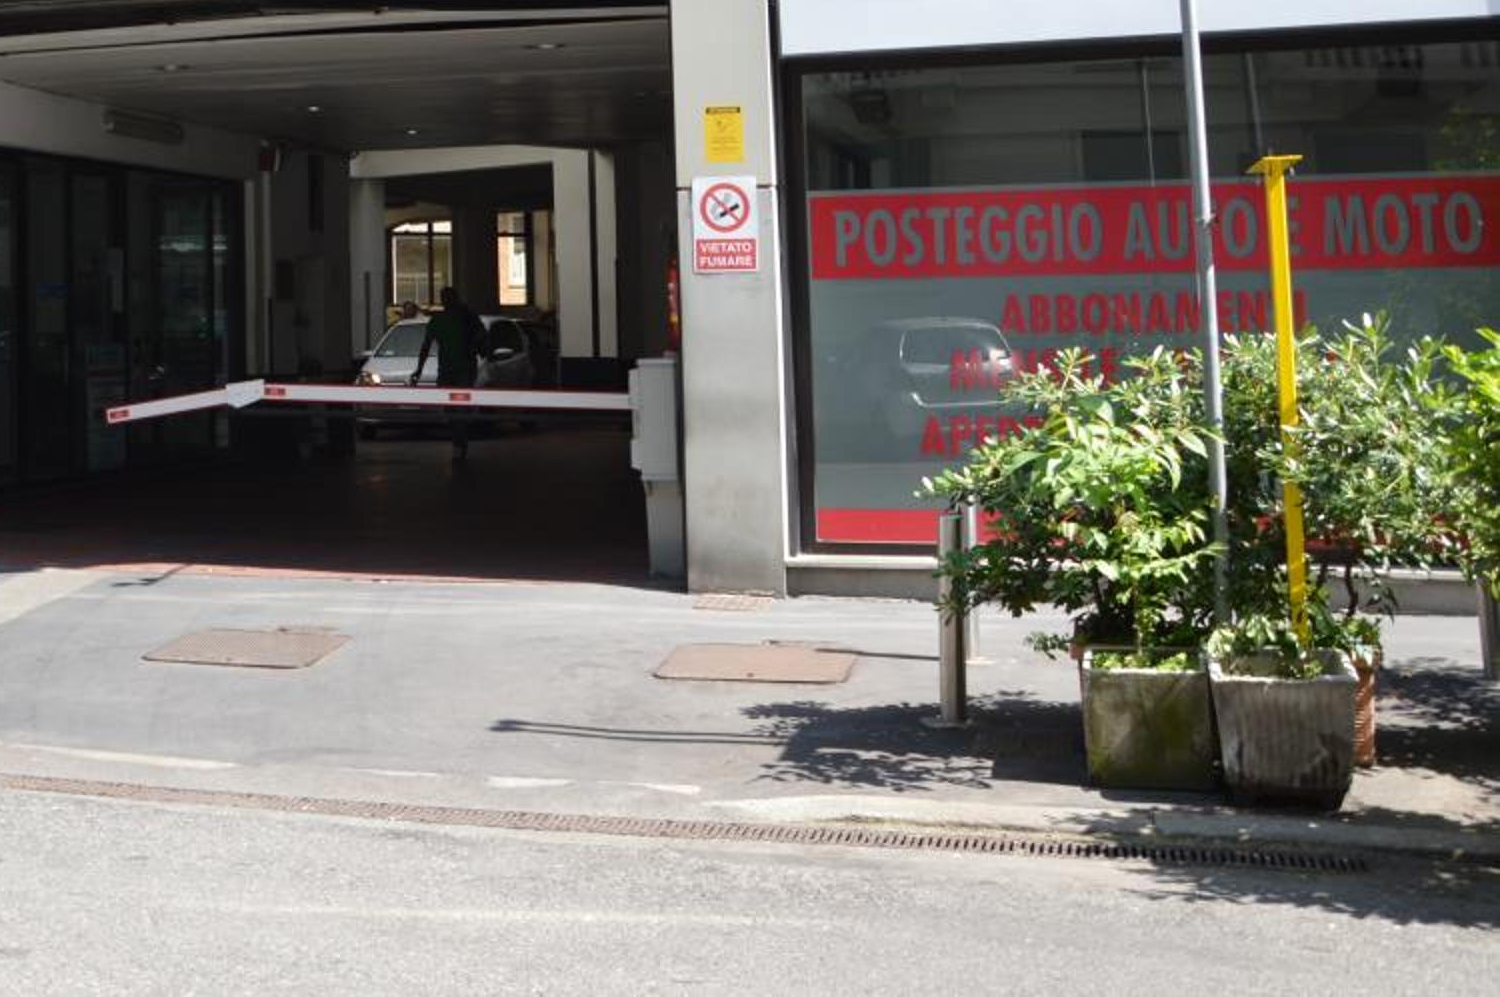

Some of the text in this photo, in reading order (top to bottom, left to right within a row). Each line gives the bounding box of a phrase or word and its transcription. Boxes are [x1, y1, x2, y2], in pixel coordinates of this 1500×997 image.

[832, 201, 1103, 268] POSTEGGIO
[1124, 196, 1258, 261] AUO
[1323, 189, 1484, 258] MOTO
[699, 241, 752, 254] VIETATO
[699, 255, 753, 268] FUMARE
[1001, 289, 1308, 336] ABBONAMENI
